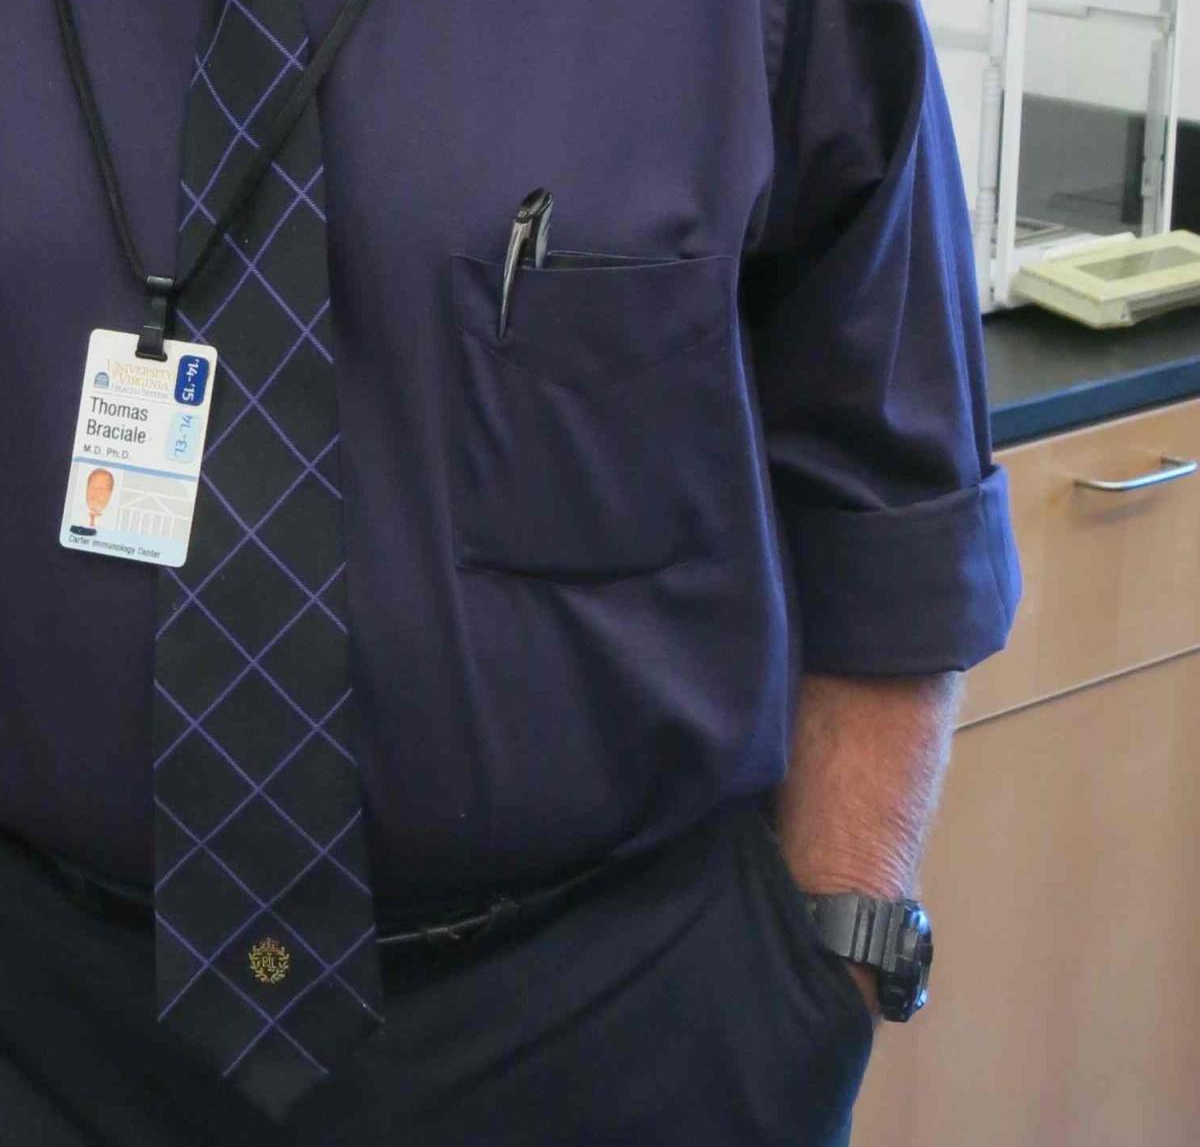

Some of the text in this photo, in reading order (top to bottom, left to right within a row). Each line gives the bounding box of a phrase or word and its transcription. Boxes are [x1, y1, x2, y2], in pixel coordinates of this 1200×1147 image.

[90, 397, 149, 421] Thomas
[86, 419, 147, 444] Braciale
[68, 534, 91, 547] Carter
[137, 547, 161, 559] Center
